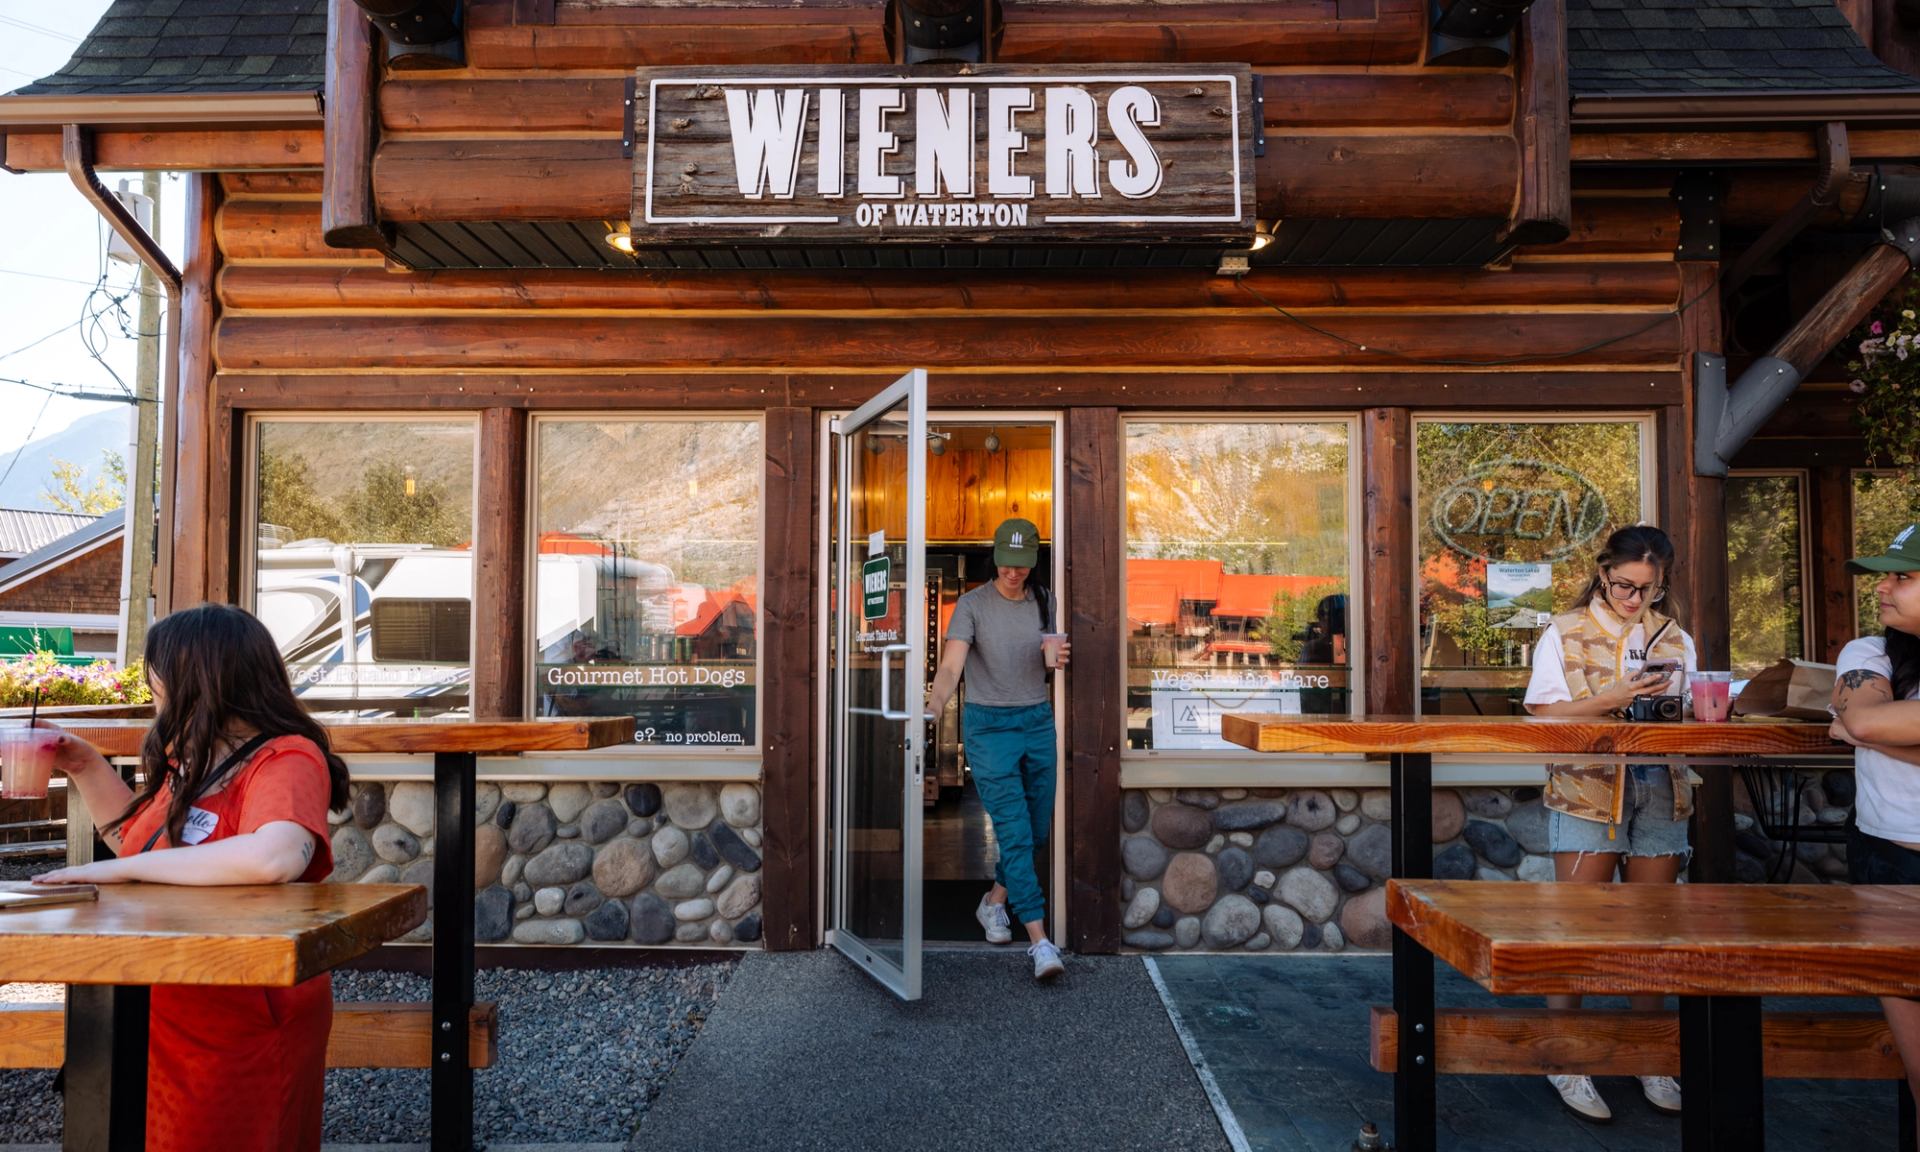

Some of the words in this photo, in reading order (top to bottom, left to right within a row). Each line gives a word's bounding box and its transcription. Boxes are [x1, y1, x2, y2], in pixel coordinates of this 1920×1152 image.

[725, 86, 1161, 199] WIENERS
[856, 203, 887, 227] OF
[894, 203, 1028, 227] WATERTON
[1444, 487, 1592, 539] OPEN
[547, 667, 643, 686] Gourmet
[649, 667, 688, 685] Hot
[694, 668, 746, 688] Dogs
[1151, 669, 1270, 690] Vegetian
[1279, 669, 1329, 688] Fare
[665, 732, 683, 742] no
[187, 811, 215, 829] ello
